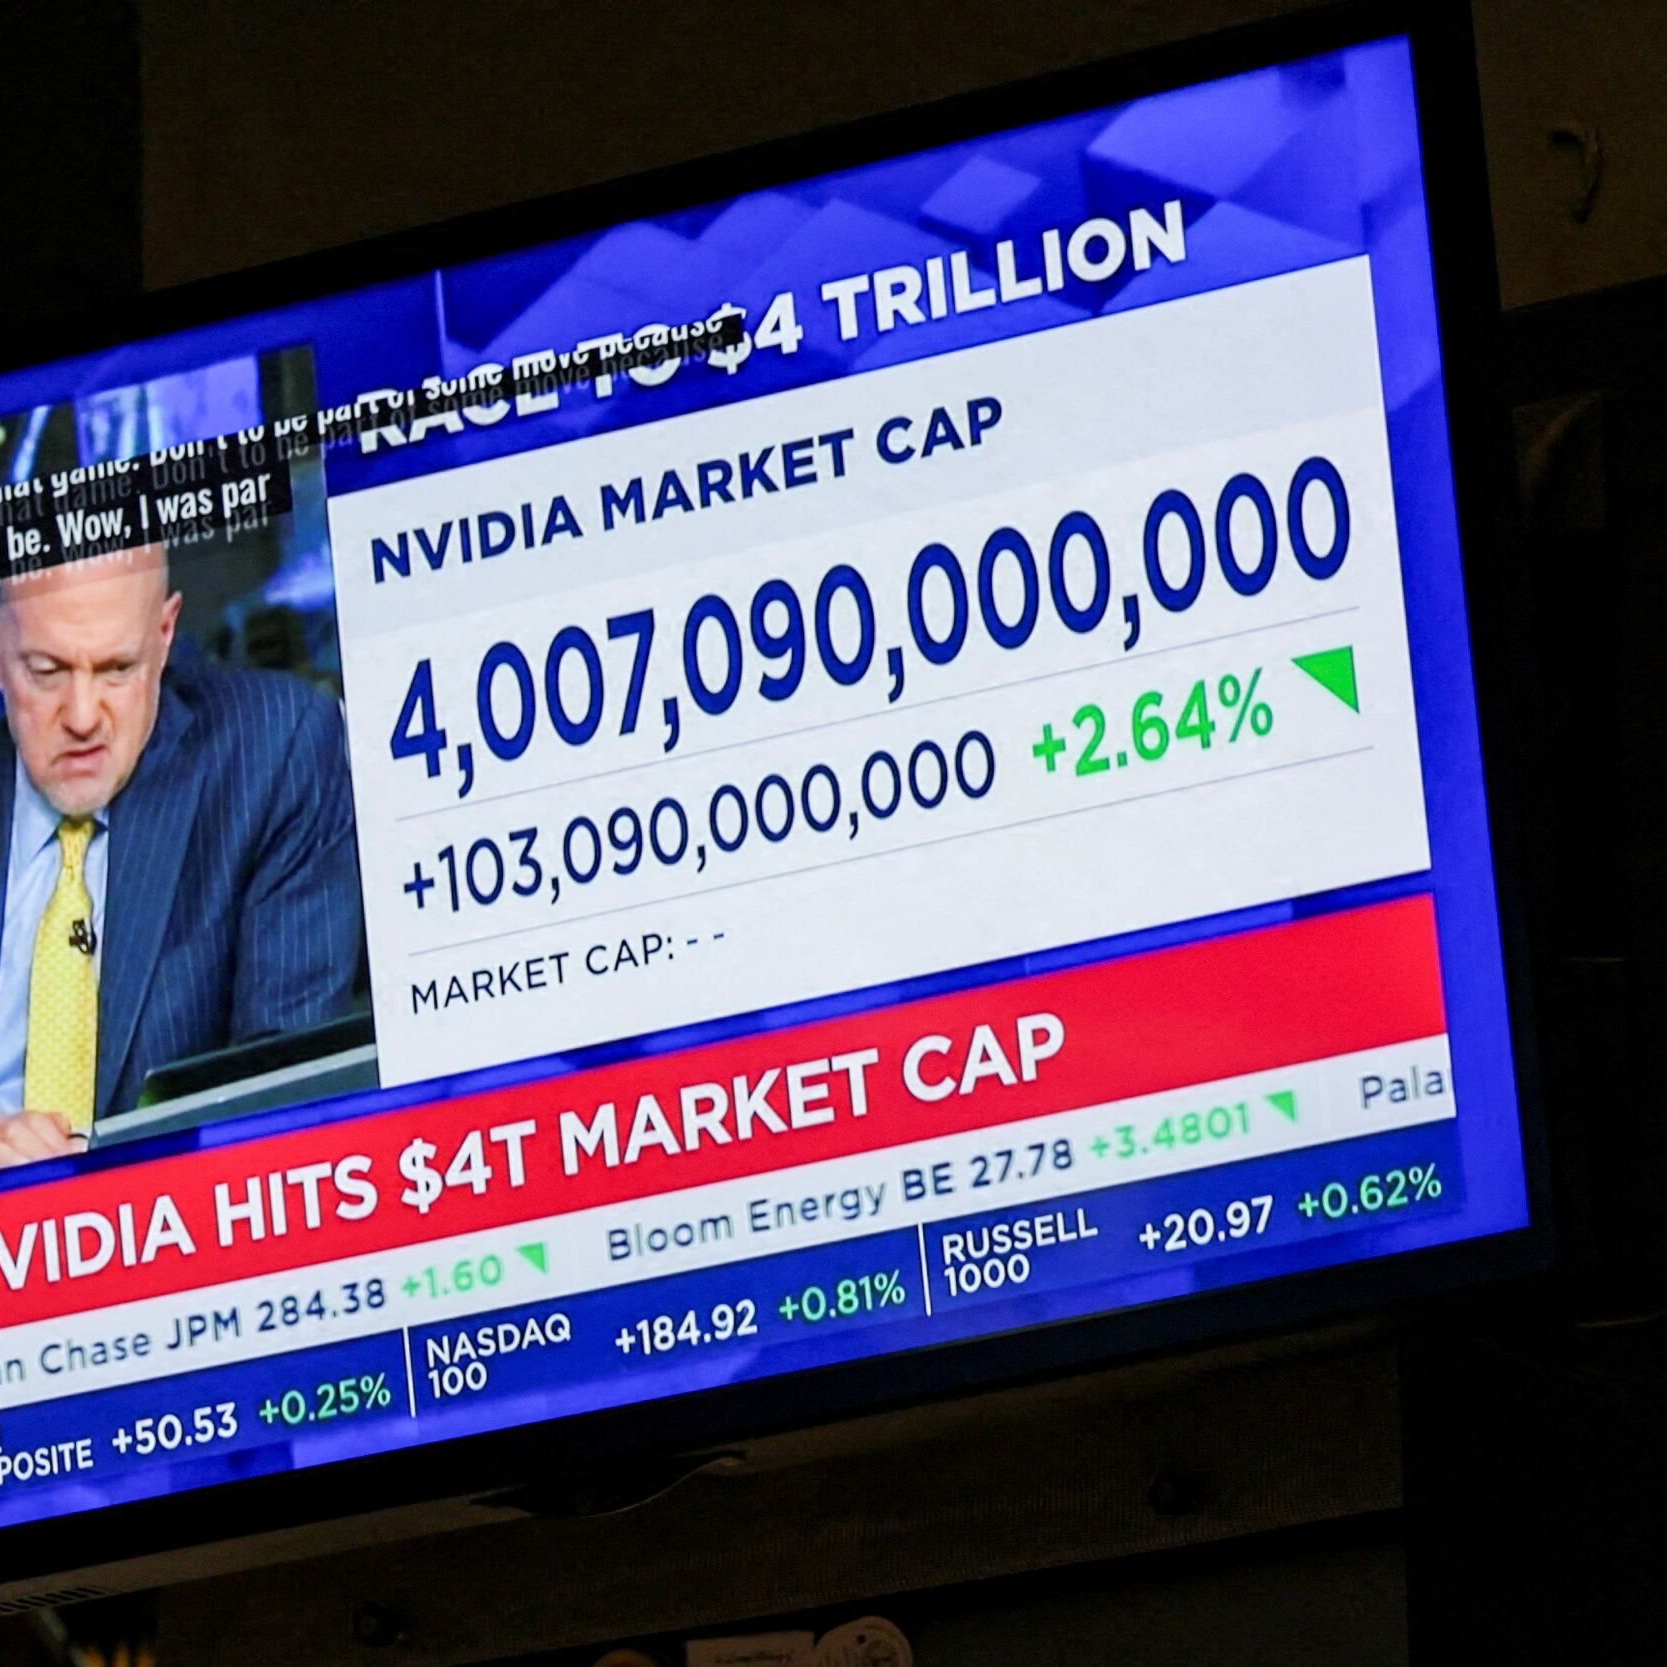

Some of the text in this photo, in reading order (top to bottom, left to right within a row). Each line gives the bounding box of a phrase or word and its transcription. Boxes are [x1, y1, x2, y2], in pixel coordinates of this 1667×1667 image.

[822, 200, 1186, 341] TRILLION
[7, 526, 51, 561] be.
[56, 508, 132, 547] Wow,
[139, 494, 149, 530] I
[157, 484, 213, 520] was
[221, 472, 272, 514] par
[371, 396, 1003, 585] NVIDIA MARKET CAP
[389, 456, 1351, 798] 4,007,090,000,000
[403, 667, 1274, 913] +103,090,000,000 +2.64%
[411, 953, 570, 1014] MARKET
[586, 932, 675, 977] CAP:
[215, 1155, 378, 1248] HITS
[399, 1119, 536, 1215] $4T
[559, 1047, 879, 1176] MARKET
[902, 1012, 1066, 1103] CAP
[40, 1330, 152, 1376] Chase
[166, 1307, 242, 1352] JPM
[257, 1278, 387, 1334] 284.38
[400, 1254, 504, 1300] +1.60
[608, 1214, 731, 1262] Bloom
[749, 1176, 887, 1234] Energy
[902, 1162, 953, 1203] BE
[971, 1138, 1074, 1188] 27.78
[1089, 1102, 1253, 1161] +3.4801
[1361, 1065, 1446, 1111] Pala
[942, 1208, 1099, 1265] RUSSELL
[1138, 1163, 1443, 1253] +20.97 +0.62%
[614, 1270, 906, 1357] +184.92 +0.81%
[943, 1253, 1031, 1298] 1000
[427, 1312, 571, 1370] NASDAQ
[428, 1361, 487, 1399] 100
[111, 1373, 392, 1456] +50.53 +0.25%
